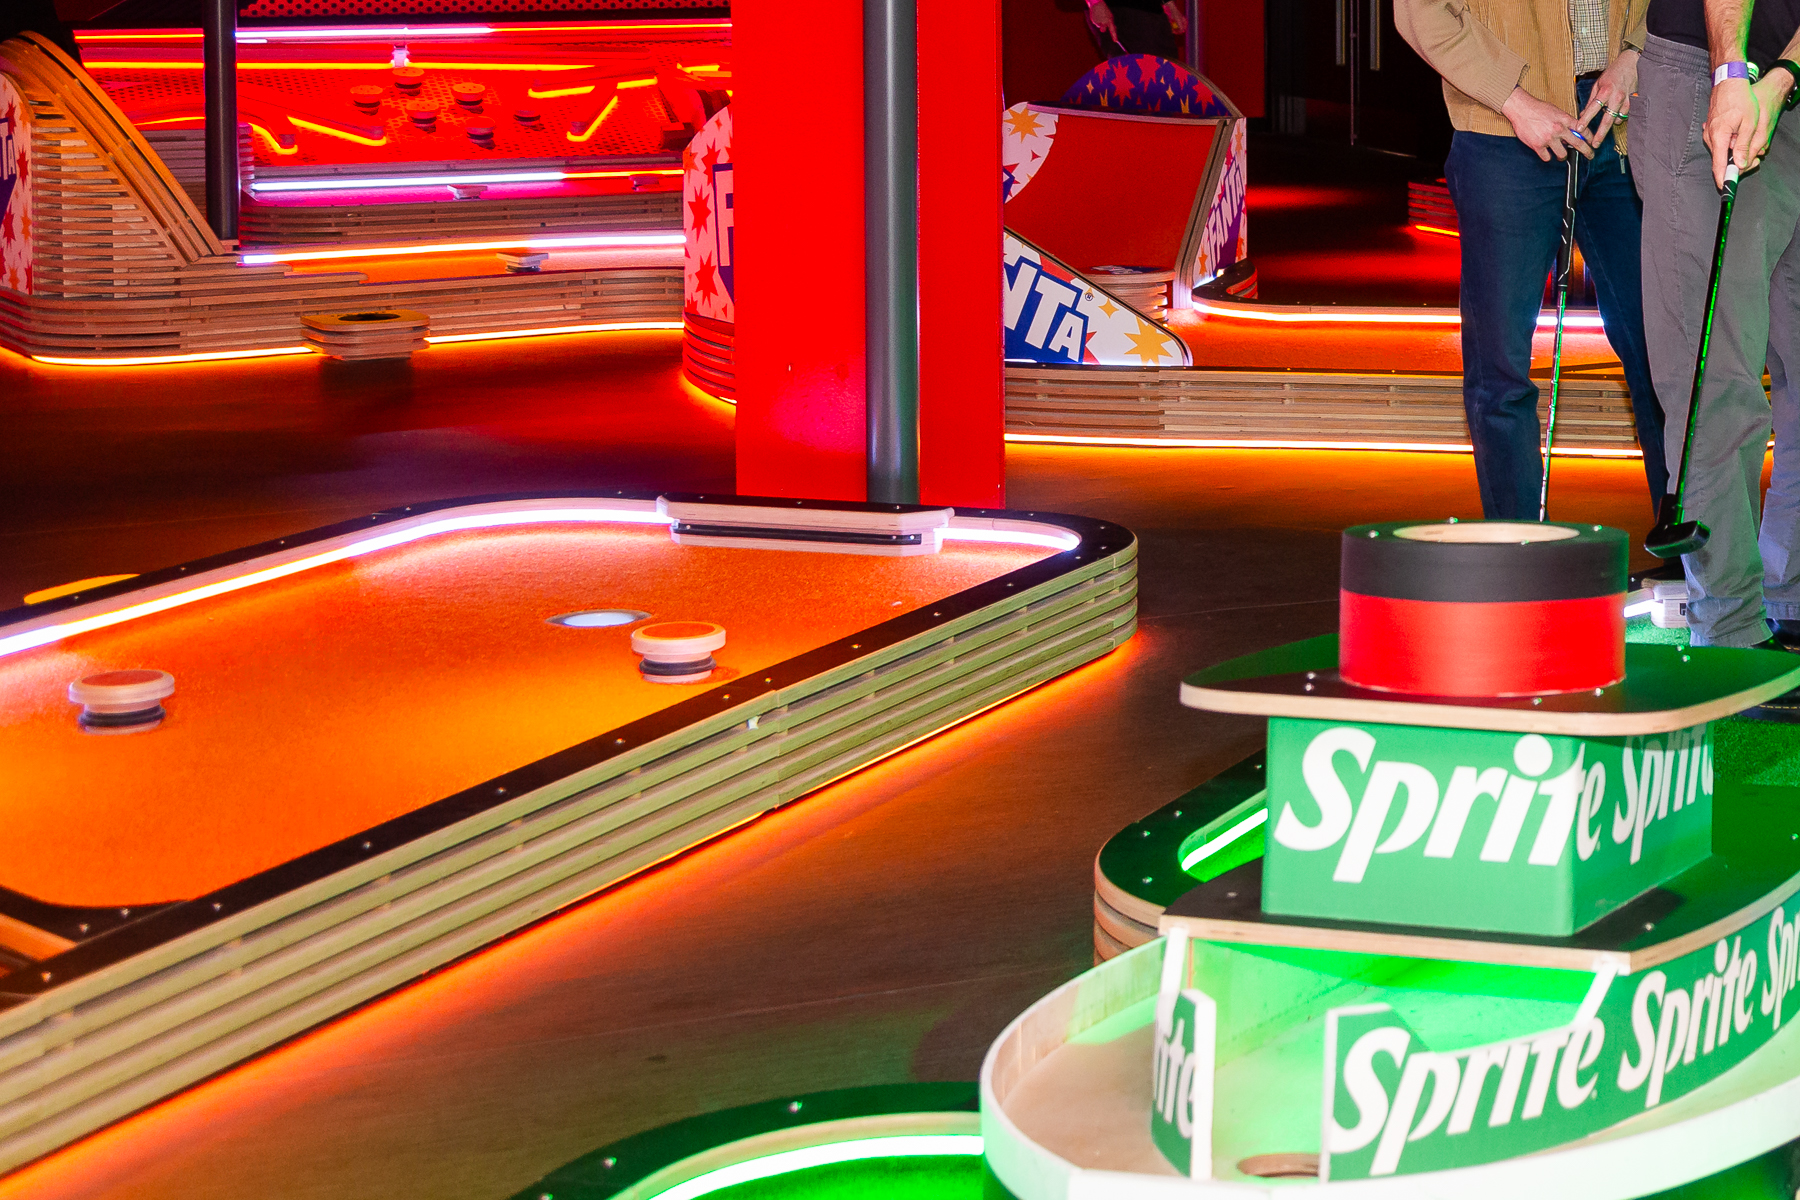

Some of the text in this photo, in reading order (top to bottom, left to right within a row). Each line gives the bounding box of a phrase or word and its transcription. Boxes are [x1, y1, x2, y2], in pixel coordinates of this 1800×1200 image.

[1207, 165, 1245, 275] FANTA
[1003, 262, 1085, 363] NTA
[1274, 726, 1606, 883] Sprite
[1329, 1016, 1606, 1177] Sprite
[1617, 934, 1758, 1109] Sprite
